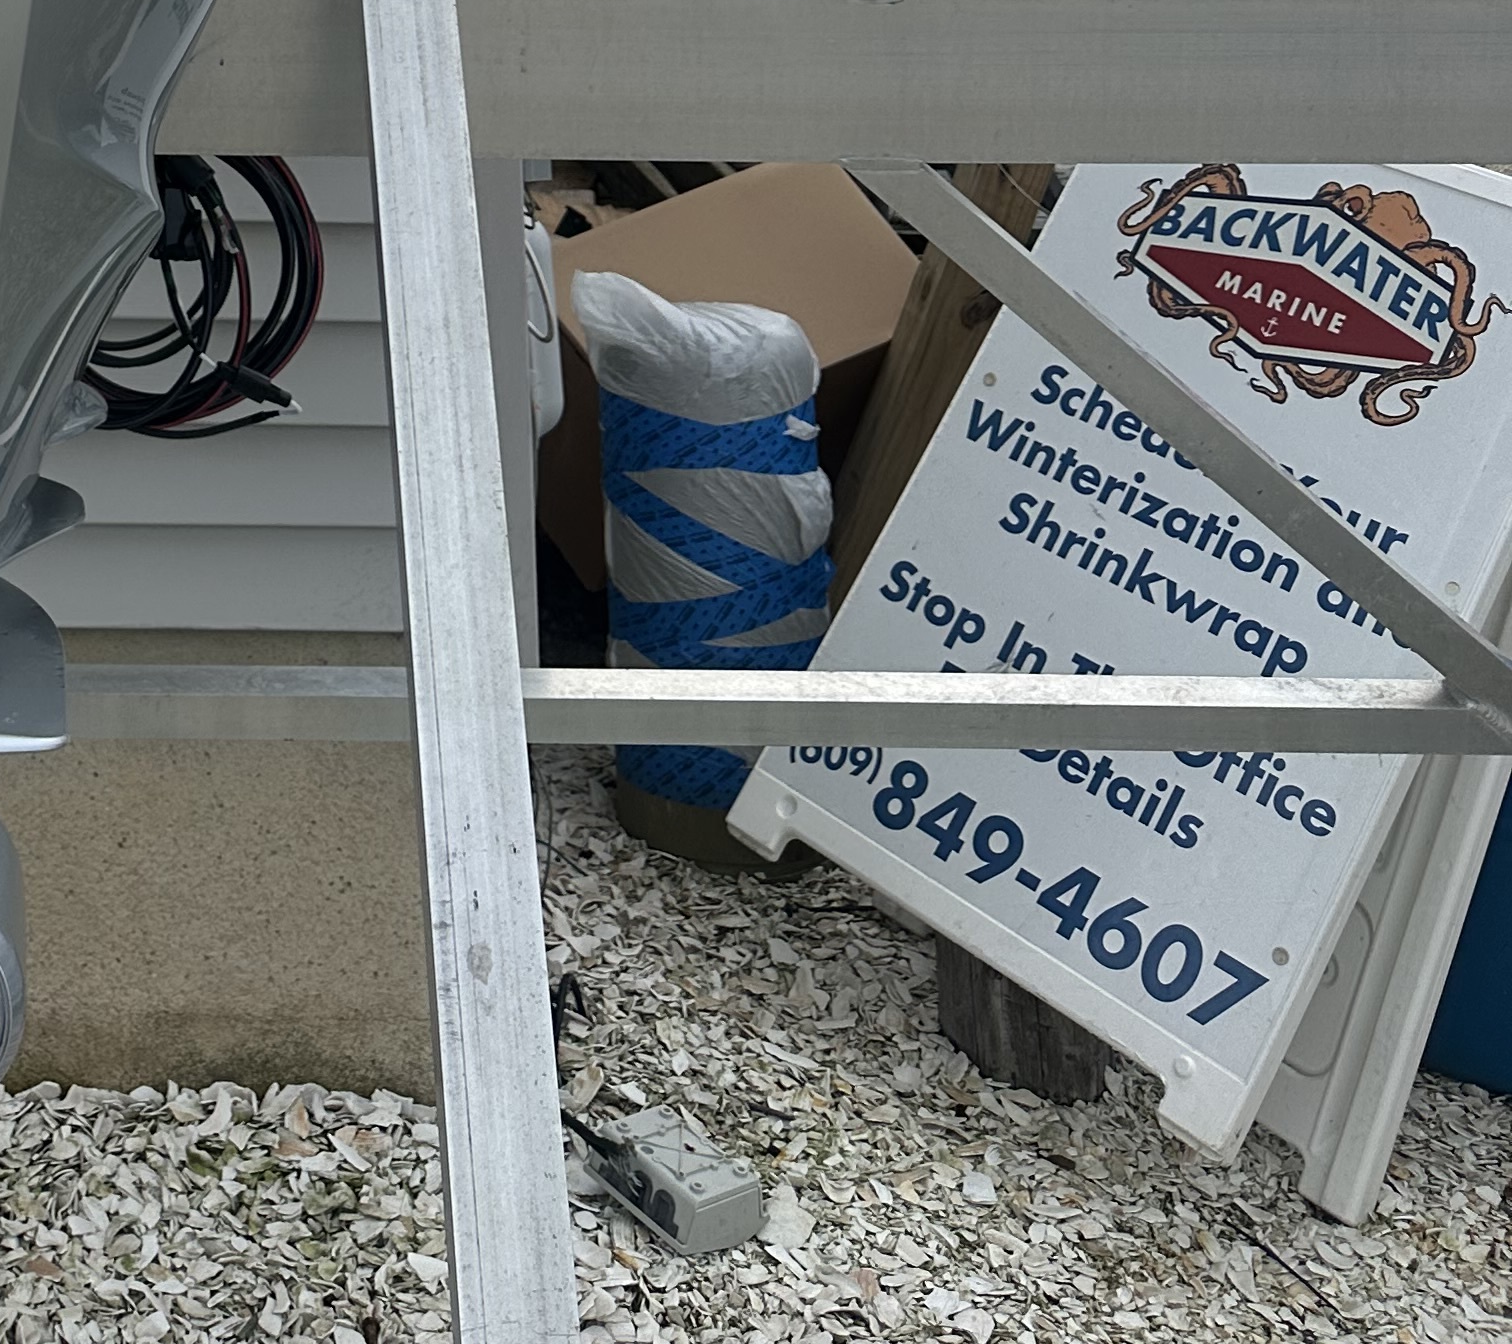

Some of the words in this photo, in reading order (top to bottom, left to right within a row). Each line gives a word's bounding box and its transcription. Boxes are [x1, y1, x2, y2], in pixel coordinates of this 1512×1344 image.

[1150, 203, 1450, 343] BACKWATER
[1215, 270, 1347, 335] MARINE
[966, 399, 1300, 592] Winterization
[879, 560, 986, 649] Stop
[999, 492, 1308, 677] Shrinkwrap
[873, 760, 1270, 1026] 849-4607
